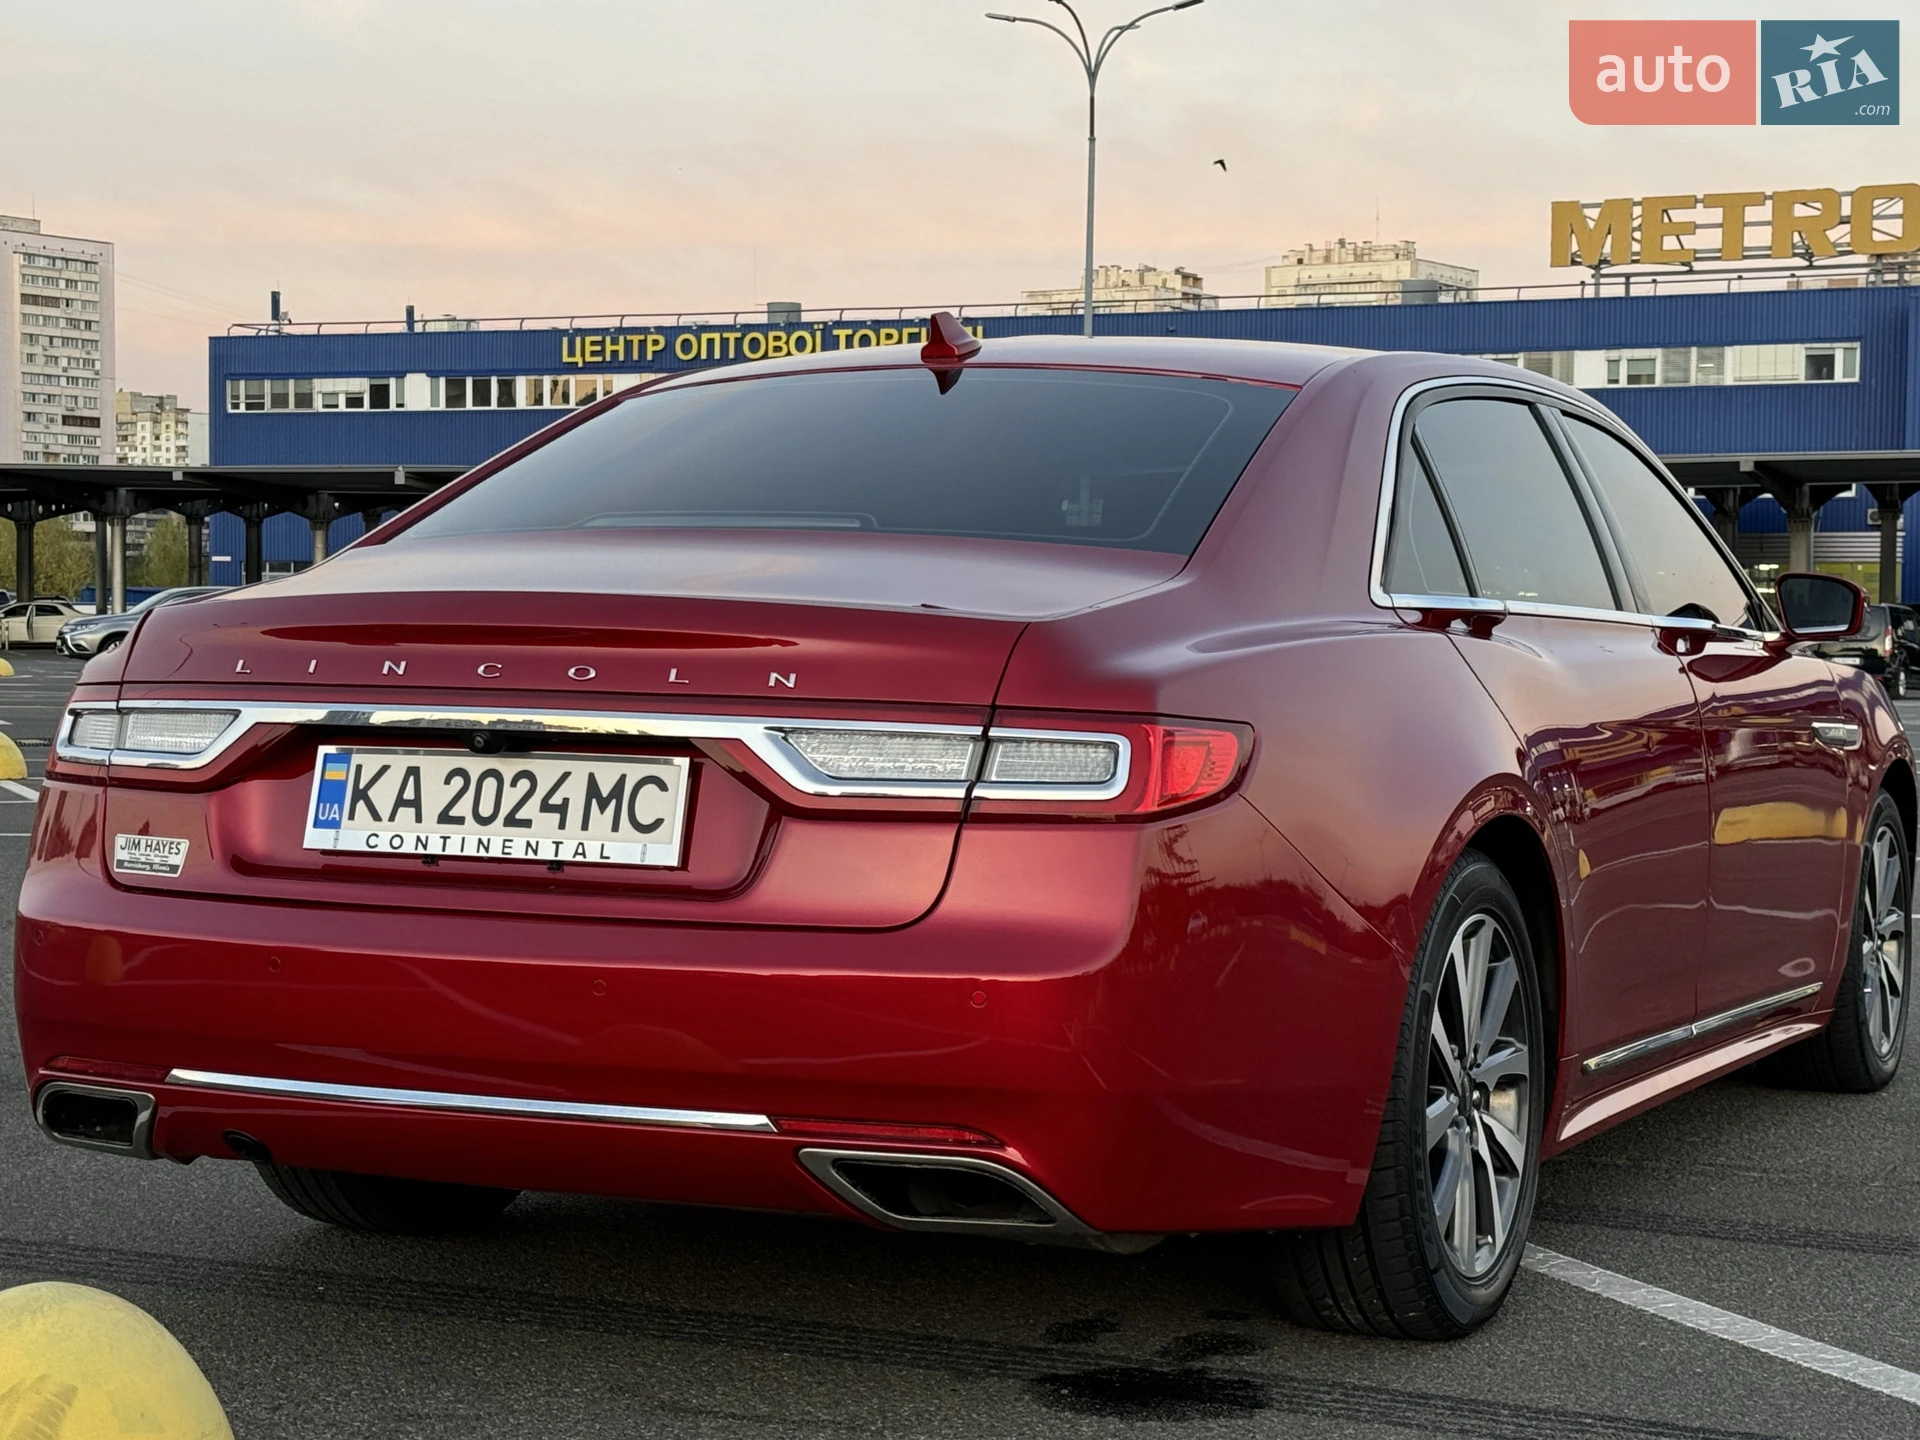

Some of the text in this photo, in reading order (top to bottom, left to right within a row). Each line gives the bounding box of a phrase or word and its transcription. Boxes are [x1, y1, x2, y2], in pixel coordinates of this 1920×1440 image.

[1550, 183, 1920, 268] METRO
[562, 334, 666, 368] ЦЕНТР
[675, 323, 823, 361] ОПТОВОЇ
[235, 659, 798, 690] LINCOLN
[318, 802, 341, 822] UA
[347, 764, 670, 835] KA 2024 MC
[120, 837, 141, 852] JIM
[144, 839, 181, 856] HAYES
[365, 833, 611, 860] CONTINENTAL
